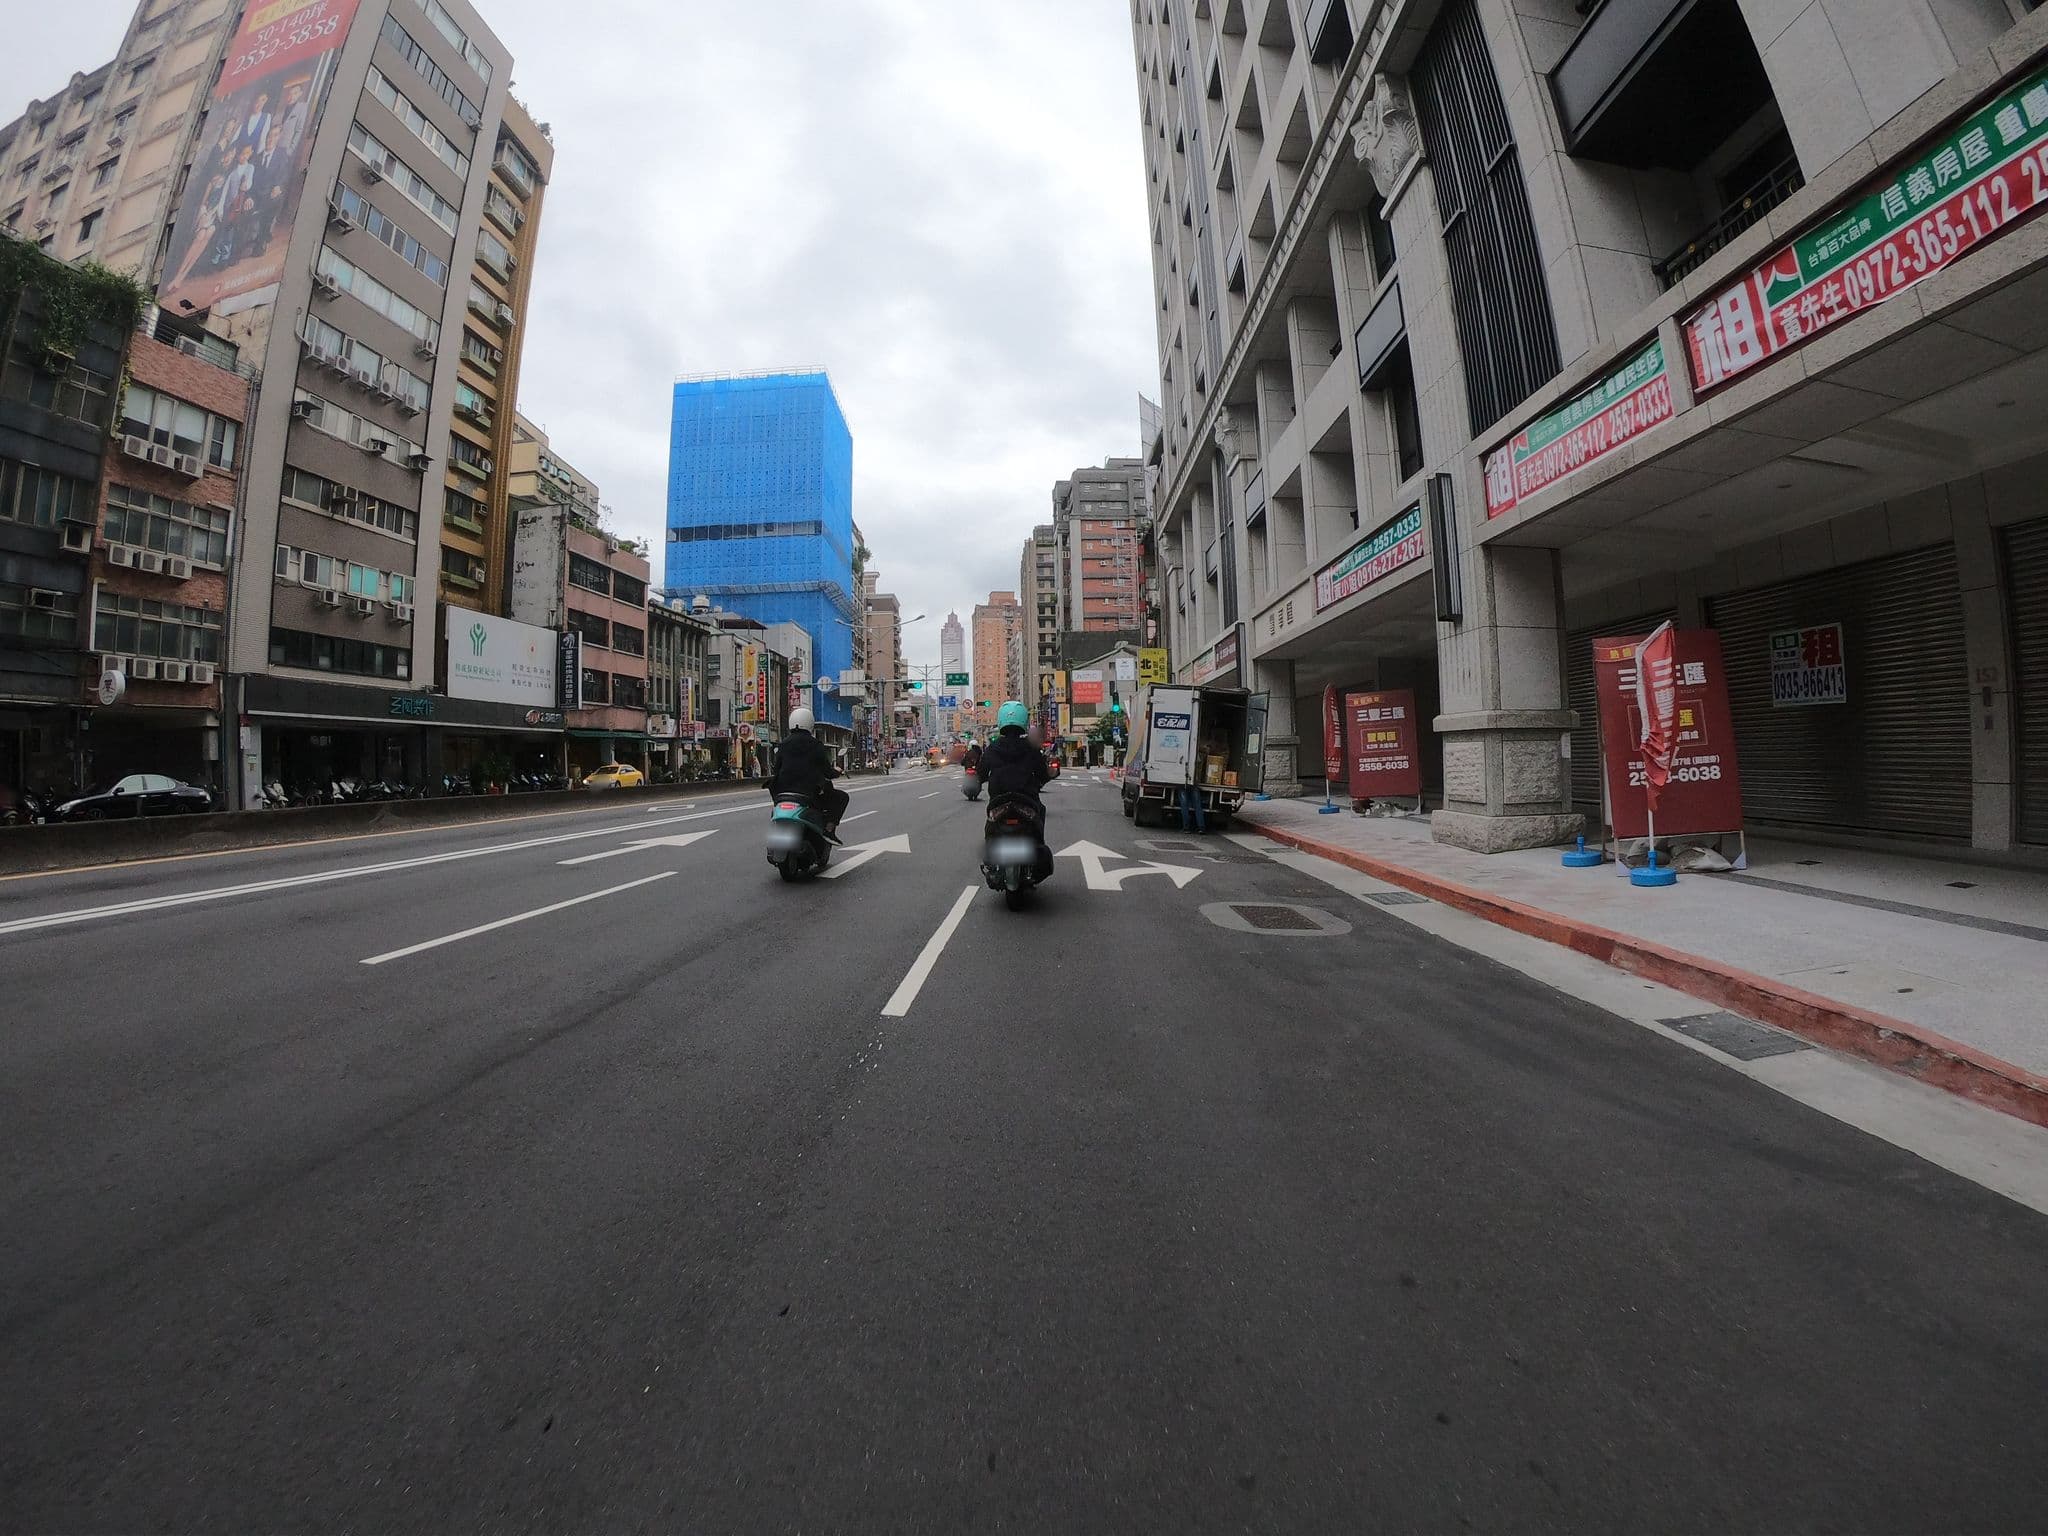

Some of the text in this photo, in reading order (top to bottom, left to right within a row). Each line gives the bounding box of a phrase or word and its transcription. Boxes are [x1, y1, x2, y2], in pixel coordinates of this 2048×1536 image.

[232, 14, 340, 76] 2552-5858
[1880, 126, 1992, 222] 信義房屋
[1692, 280, 1764, 386] 租
[1608, 379, 1670, 444] 2557-0333
[1373, 510, 1421, 553] 2557-0333
[1801, 627, 1841, 668] 租
[1774, 667, 1844, 699] 0935-966413
[1157, 718, 1188, 729] 宅配通
[1359, 761, 1409, 772] 2558-6038
